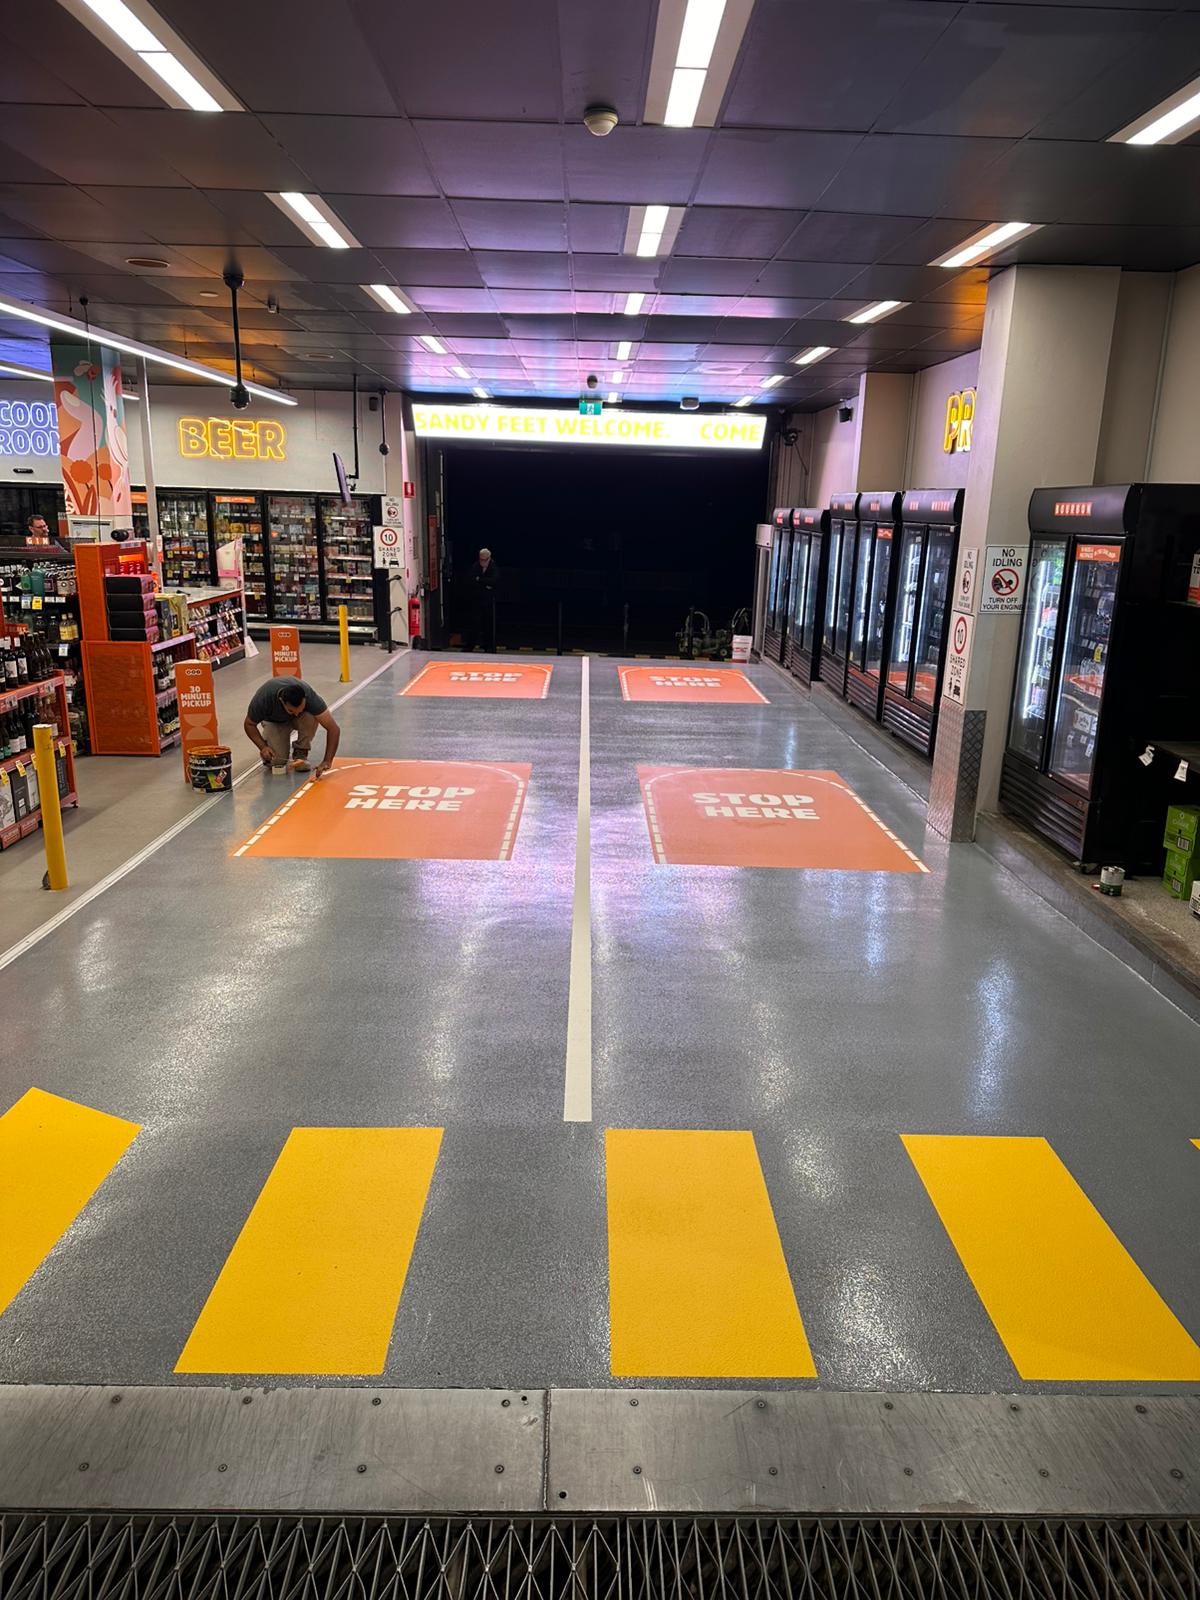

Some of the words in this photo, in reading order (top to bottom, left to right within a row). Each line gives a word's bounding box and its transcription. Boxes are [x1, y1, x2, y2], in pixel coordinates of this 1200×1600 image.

[415, 412, 489, 431] SANDY
[497, 415, 547, 433] FEET
[556, 418, 670, 438] WELCOME.
[701, 422, 760, 441] COME
[179, 418, 285, 459] BEER
[1055, 503, 1092, 516] BOURBON
[27, 537, 49, 545] GIN
[384, 534, 393, 542] 10
[1002, 548, 1016, 557] NO
[992, 558, 1023, 567] IDLING
[180, 692, 211, 700] MINUTE
[181, 699, 212, 707] PICKUP
[348, 784, 475, 798] STOP
[344, 797, 463, 811] HERE
[692, 793, 814, 806] STOP
[704, 806, 820, 819] HERE
